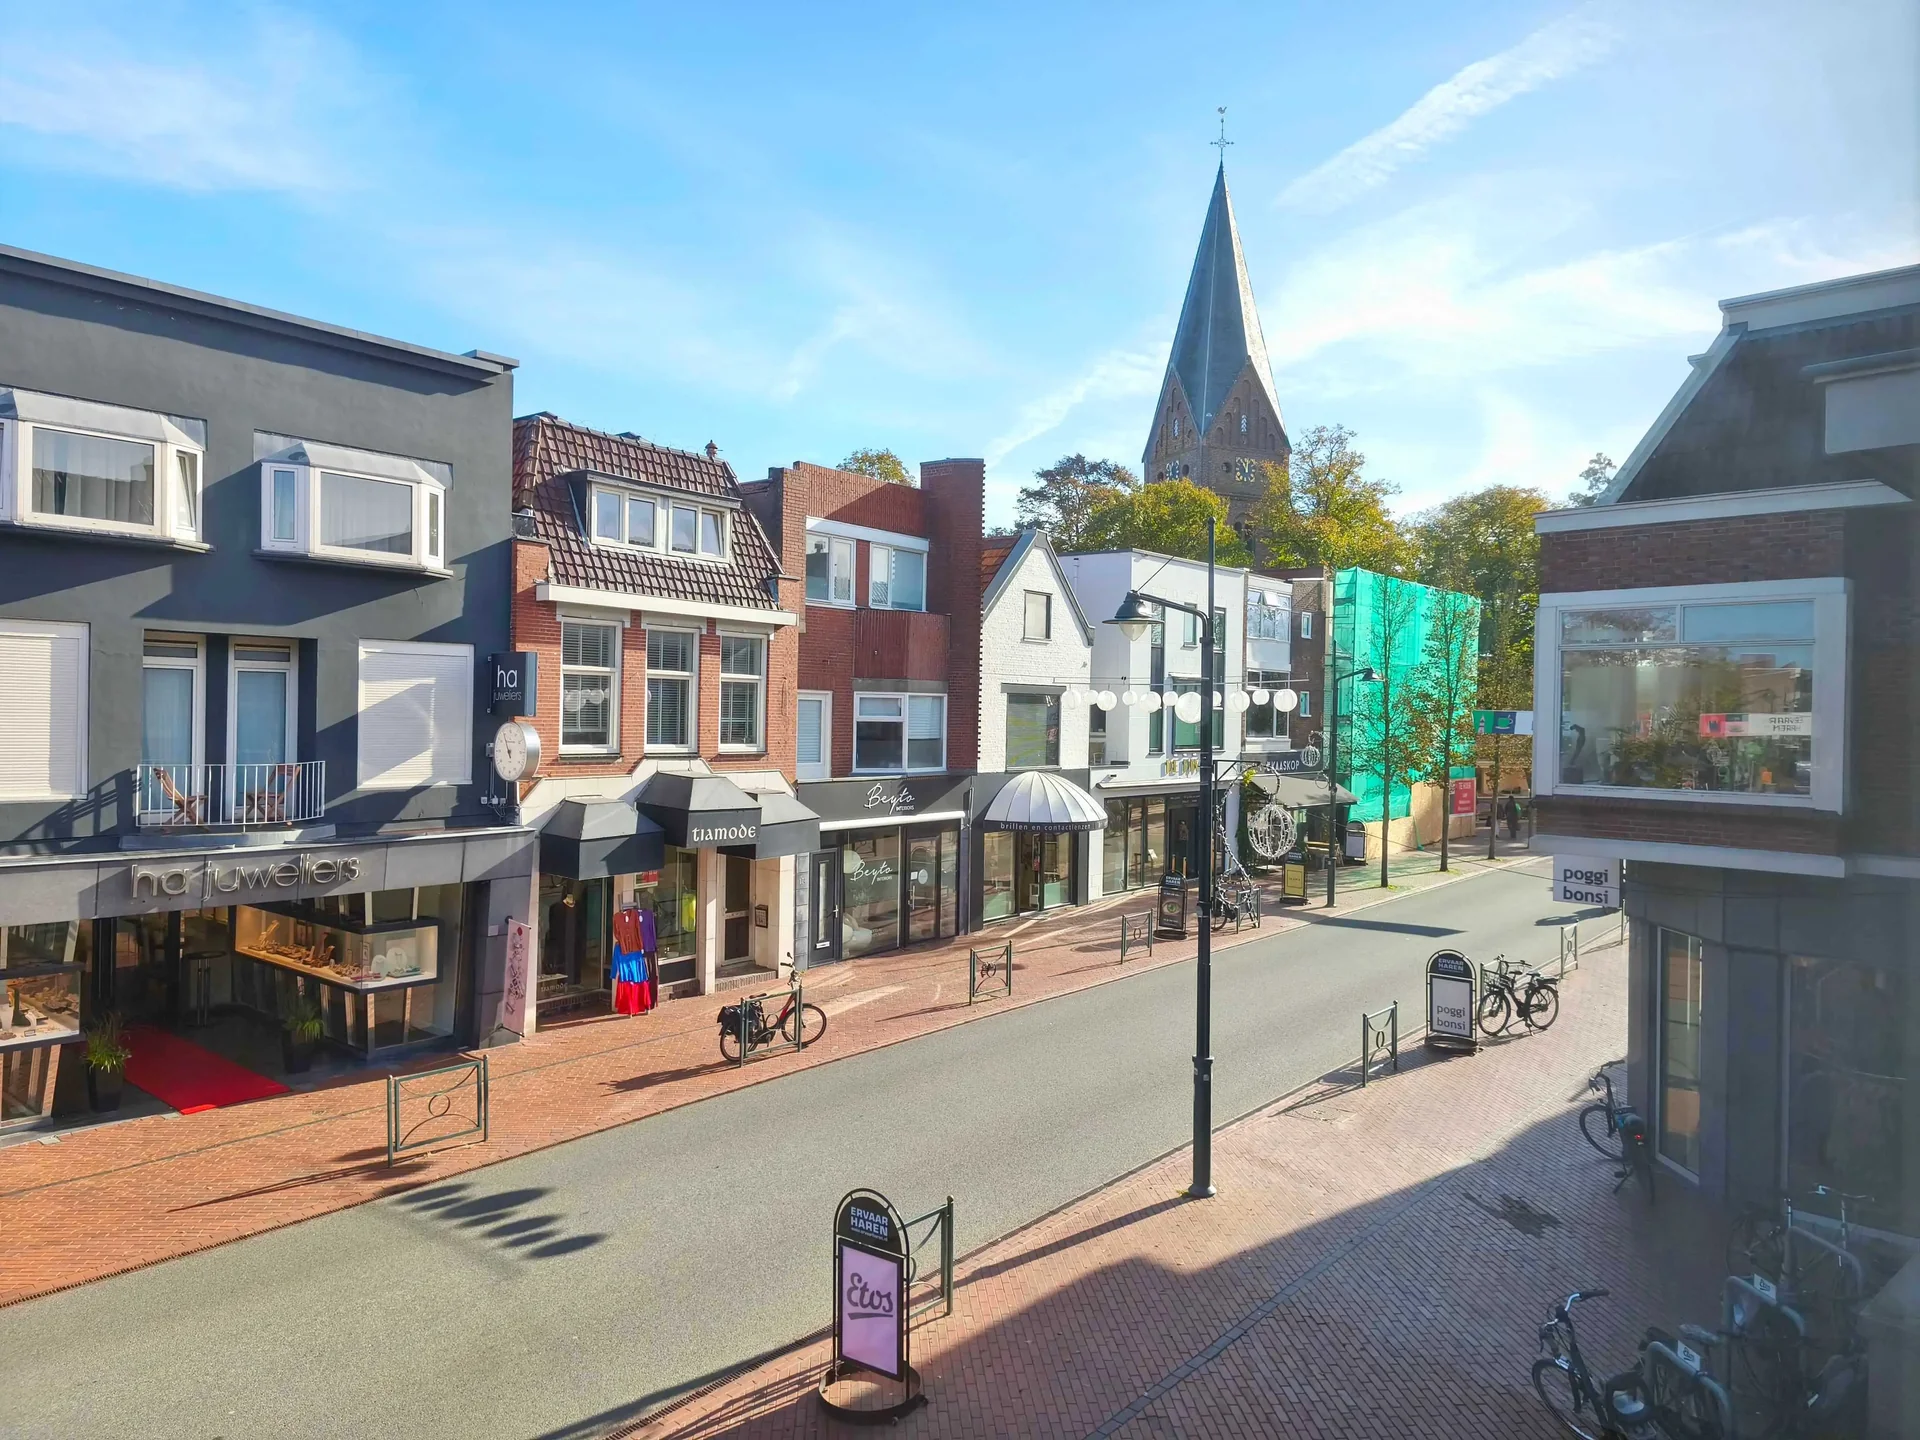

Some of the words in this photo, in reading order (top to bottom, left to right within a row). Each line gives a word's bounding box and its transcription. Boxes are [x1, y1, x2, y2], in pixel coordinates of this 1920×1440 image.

[497, 665, 518, 688] ha
[493, 689, 522, 703] juweliers
[1271, 760, 1300, 771] KAASKOP
[863, 782, 915, 815] Beyto
[1000, 822, 1028, 830] brillen
[131, 864, 190, 898] ha
[201, 853, 361, 902] juweliers
[850, 859, 893, 885] Beyto
[1563, 868, 1609, 885] poggi
[1563, 886, 1609, 904] bonsi
[1438, 958, 1464, 966] ERVAAR
[1438, 963, 1464, 971] HAREN
[1436, 1005, 1466, 1018] poggi
[1436, 1017, 1466, 1031] bonsi
[851, 1206, 889, 1226] ERVAAR
[851, 1216, 888, 1236] HAREN
[847, 1272, 894, 1313] Etos
